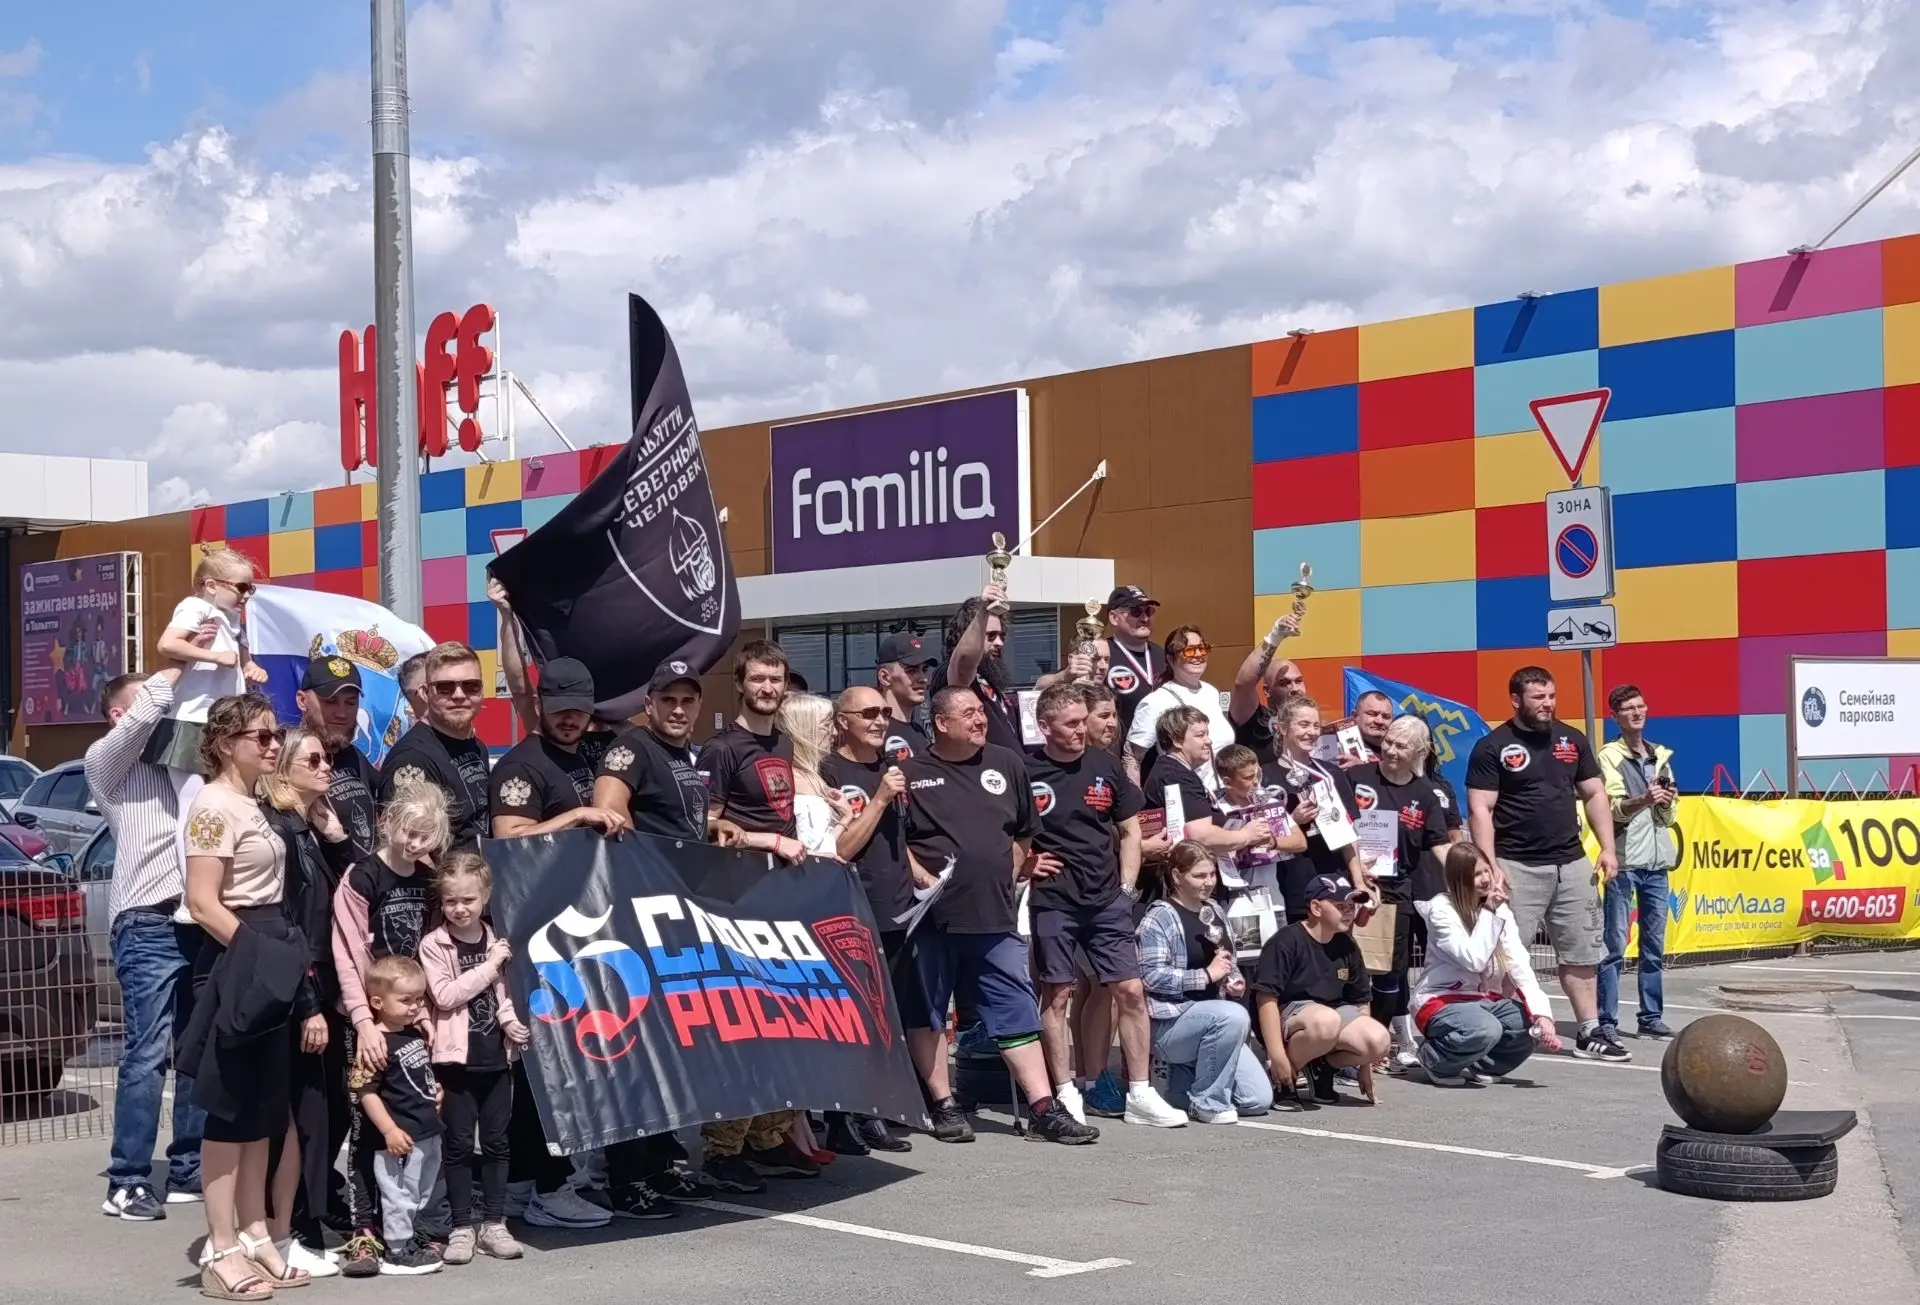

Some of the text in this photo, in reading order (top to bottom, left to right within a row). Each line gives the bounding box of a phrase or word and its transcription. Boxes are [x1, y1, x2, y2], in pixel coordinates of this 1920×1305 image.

[339, 304, 495, 471] Hff
[636, 404, 684, 462] ЛЬЯТТИ
[614, 427, 699, 523] ЕВЕРНЫЙ
[627, 456, 702, 529] ЧЕЛОВЕК
[792, 446, 996, 539] familia
[1556, 498, 1592, 514] ЗОНА
[24, 588, 117, 615] зажигаем звёзды
[701, 601, 719, 623] 2022
[25, 623, 30, 632] в
[1839, 689, 1896, 706] Семейная
[1839, 710, 1895, 727] парковка
[909, 777, 945, 790] СУДЬЯ
[1358, 821, 1389, 829] ДИПЛОМ
[1692, 839, 1805, 872] Мбит/сек
[1807, 847, 1830, 869] за
[1694, 892, 1786, 919] ИнфоЛада
[1823, 894, 1897, 919] 600-603
[1759, 921, 1782, 931] офиса
[660, 975, 870, 1047] РОССИИ
